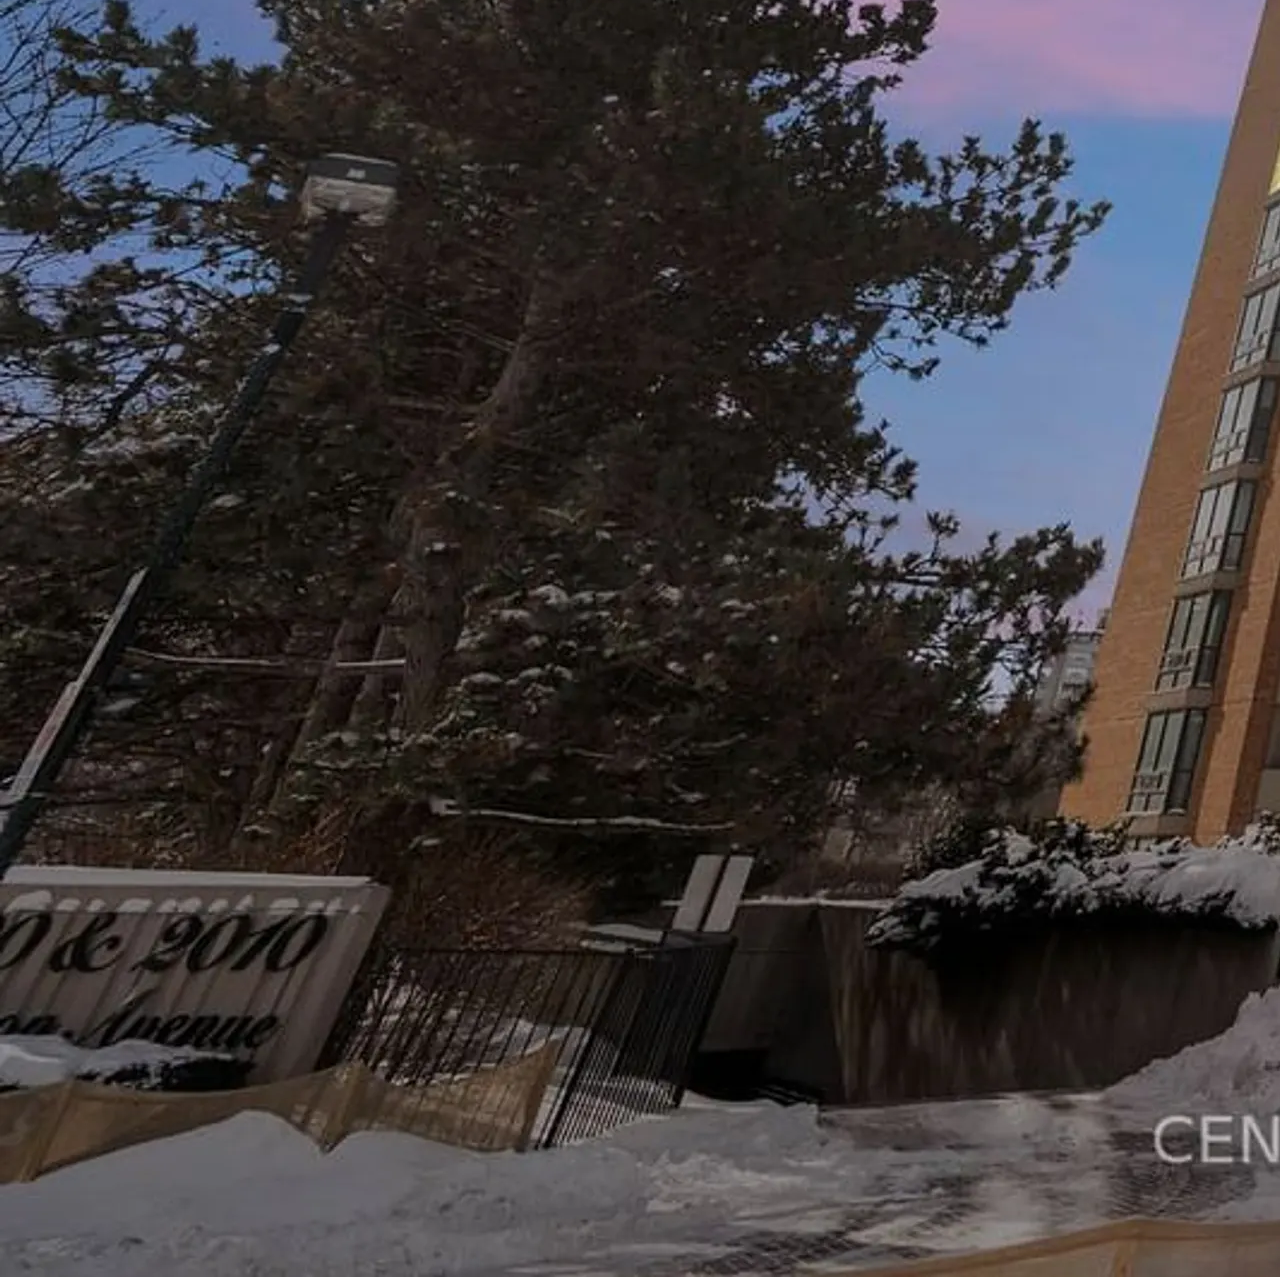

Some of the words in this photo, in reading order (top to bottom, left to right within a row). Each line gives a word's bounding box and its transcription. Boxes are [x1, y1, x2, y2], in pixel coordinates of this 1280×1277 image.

[50, 911, 122, 972] &
[130, 910, 328, 972] 2010
[74, 987, 285, 1051] Avenue
